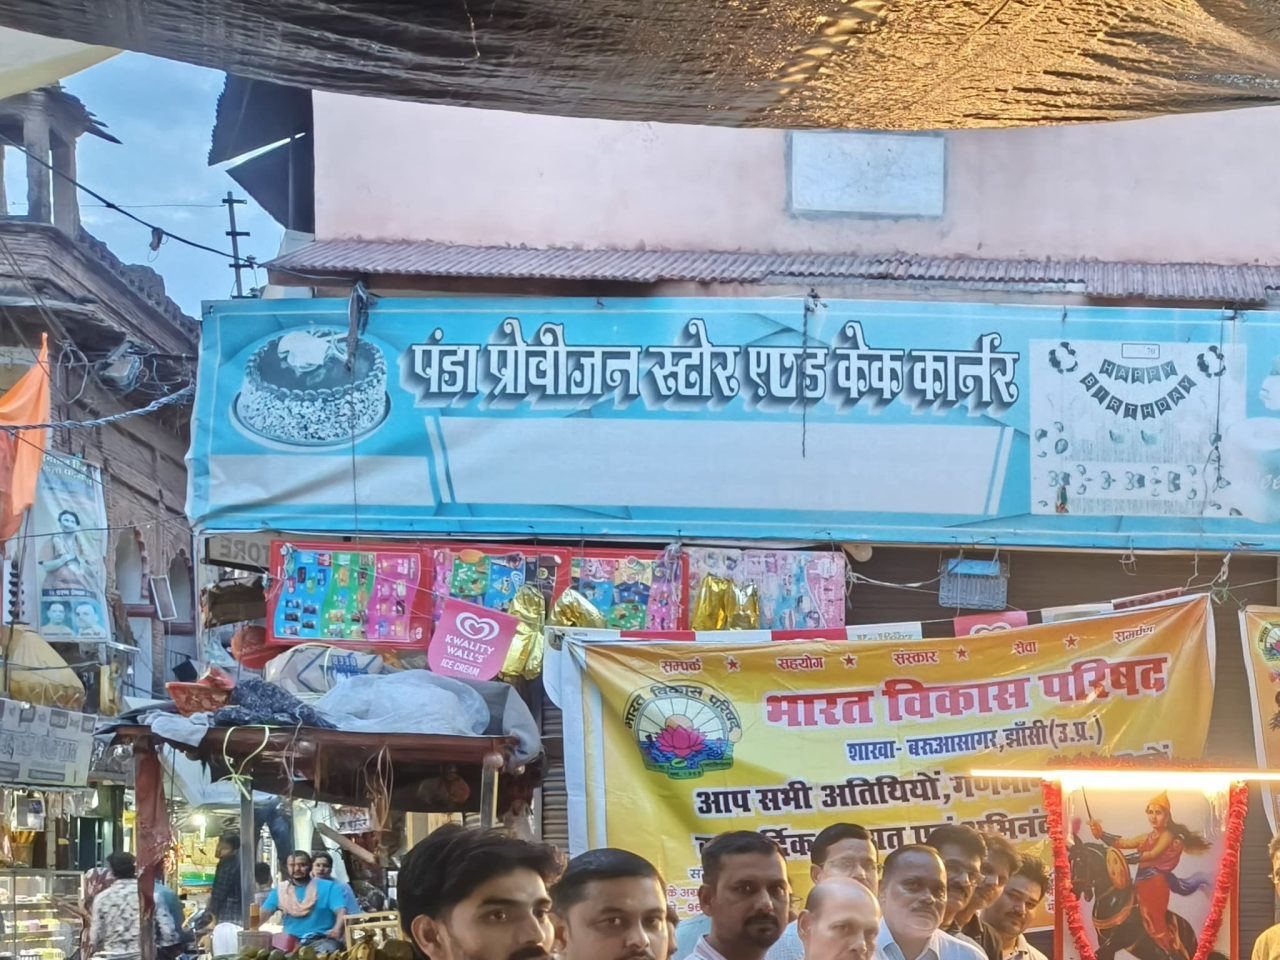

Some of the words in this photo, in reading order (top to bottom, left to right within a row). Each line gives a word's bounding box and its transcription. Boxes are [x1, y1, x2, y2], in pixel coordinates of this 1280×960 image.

[411, 327, 481, 394] पंडा
[486, 317, 642, 397] प्रोवीजन
[649, 318, 740, 398] स्टोर
[747, 345, 829, 399] एण्ड
[834, 319, 905, 400] केक
[909, 331, 1020, 404] कार्नर
[1102, 362, 1172, 379] HAPPY
[1085, 375, 1191, 416] BIRTHDAY
[445, 634, 495, 655] KWALITY
[447, 645, 485, 663] WALL'S
[777, 655, 825, 671] सहयोग
[893, 649, 938, 666] संस्कार
[1014, 640, 1037, 655] सेवा
[1114, 624, 1155, 643] समर्पण
[440, 658, 455, 669] ICE
[453, 662, 480, 676] CREAM
[766, 690, 875, 727] भारत
[881, 678, 1031, 721] विकास
[1038, 657, 1168, 702] परिषद
[696, 790, 752, 814] आप
[755, 779, 813, 811] सभी
